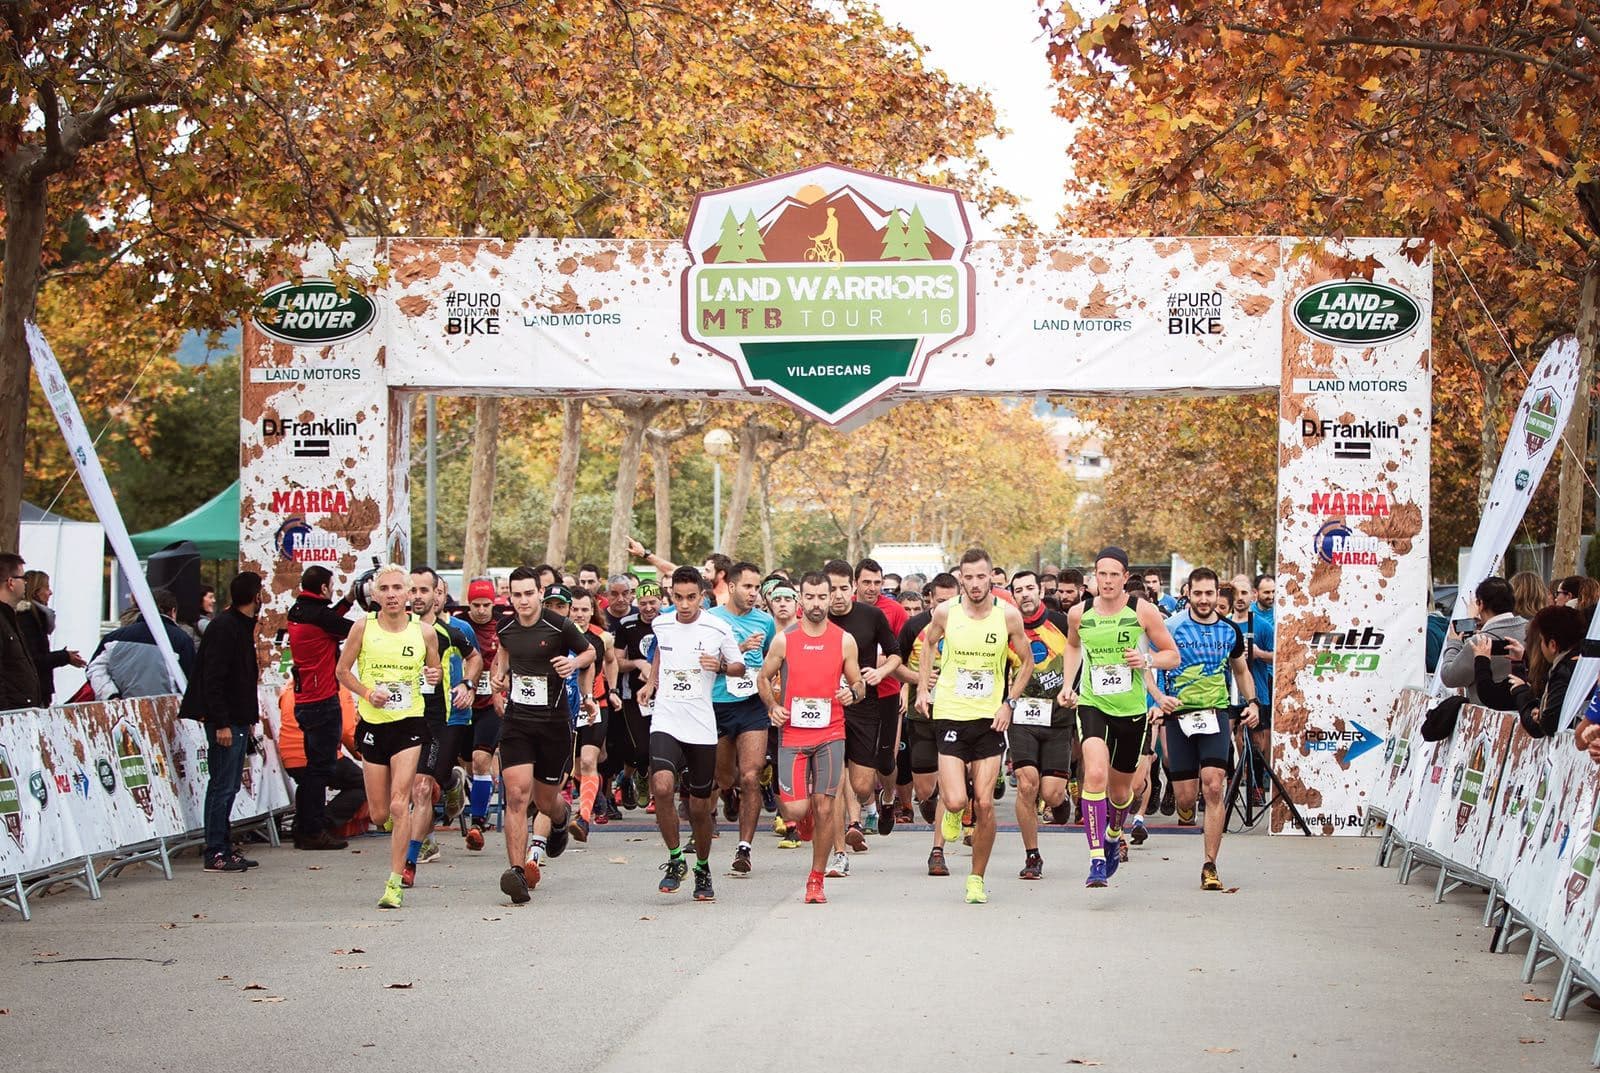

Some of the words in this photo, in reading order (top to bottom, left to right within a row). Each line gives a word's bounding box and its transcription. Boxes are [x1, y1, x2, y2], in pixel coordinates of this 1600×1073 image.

[699, 276, 781, 302] LAND
[786, 274, 954, 301] WARRIORS
[277, 293, 338, 310] LAND
[446, 292, 500, 307] #PURO
[1167, 292, 1222, 307] #PURO
[1317, 292, 1381, 311] LAND
[447, 308, 500, 317] MOUNTAIN
[702, 307, 783, 330] MTB
[799, 309, 883, 328] TOUR
[906, 308, 952, 327] '16
[1168, 308, 1221, 317] MOUNTAIN
[281, 311, 356, 329] ROVER
[447, 317, 500, 335] BIKE
[523, 315, 560, 327] LAND
[562, 313, 621, 325] MOTORS
[1033, 319, 1070, 331] LAND
[1073, 320, 1132, 332] MOTORS
[1168, 317, 1222, 335] BIKE
[1322, 312, 1400, 330] ROVER
[265, 369, 300, 380] LAND
[303, 368, 361, 380] MOTORS
[786, 364, 872, 377] VILADECANS
[1309, 380, 1345, 392] LAND
[1348, 380, 1408, 392] MOTORS
[262, 418, 357, 436] D.Franklin
[1301, 419, 1399, 439] D.Franklin
[271, 490, 348, 513] MARCA
[1311, 492, 1390, 516] MARCA
[292, 532, 338, 549] RADIO
[1332, 535, 1378, 551] RADIO
[292, 549, 338, 561] MARCA
[1331, 552, 1378, 565] MARCA
[985, 633, 997, 644] LS
[1117, 631, 1130, 643] LS
[402, 646, 414, 657] LS
[672, 682, 692, 691] 250
[736, 680, 754, 689] 229
[966, 682, 984, 690] 241
[1102, 676, 1122, 686] 242
[520, 688, 536, 697] 196
[801, 711, 821, 719] 202
[1024, 709, 1041, 717] 144
[1305, 730, 1364, 742] POWER
[1291, 813, 1332, 829] pwered
[1334, 813, 1346, 829] by
